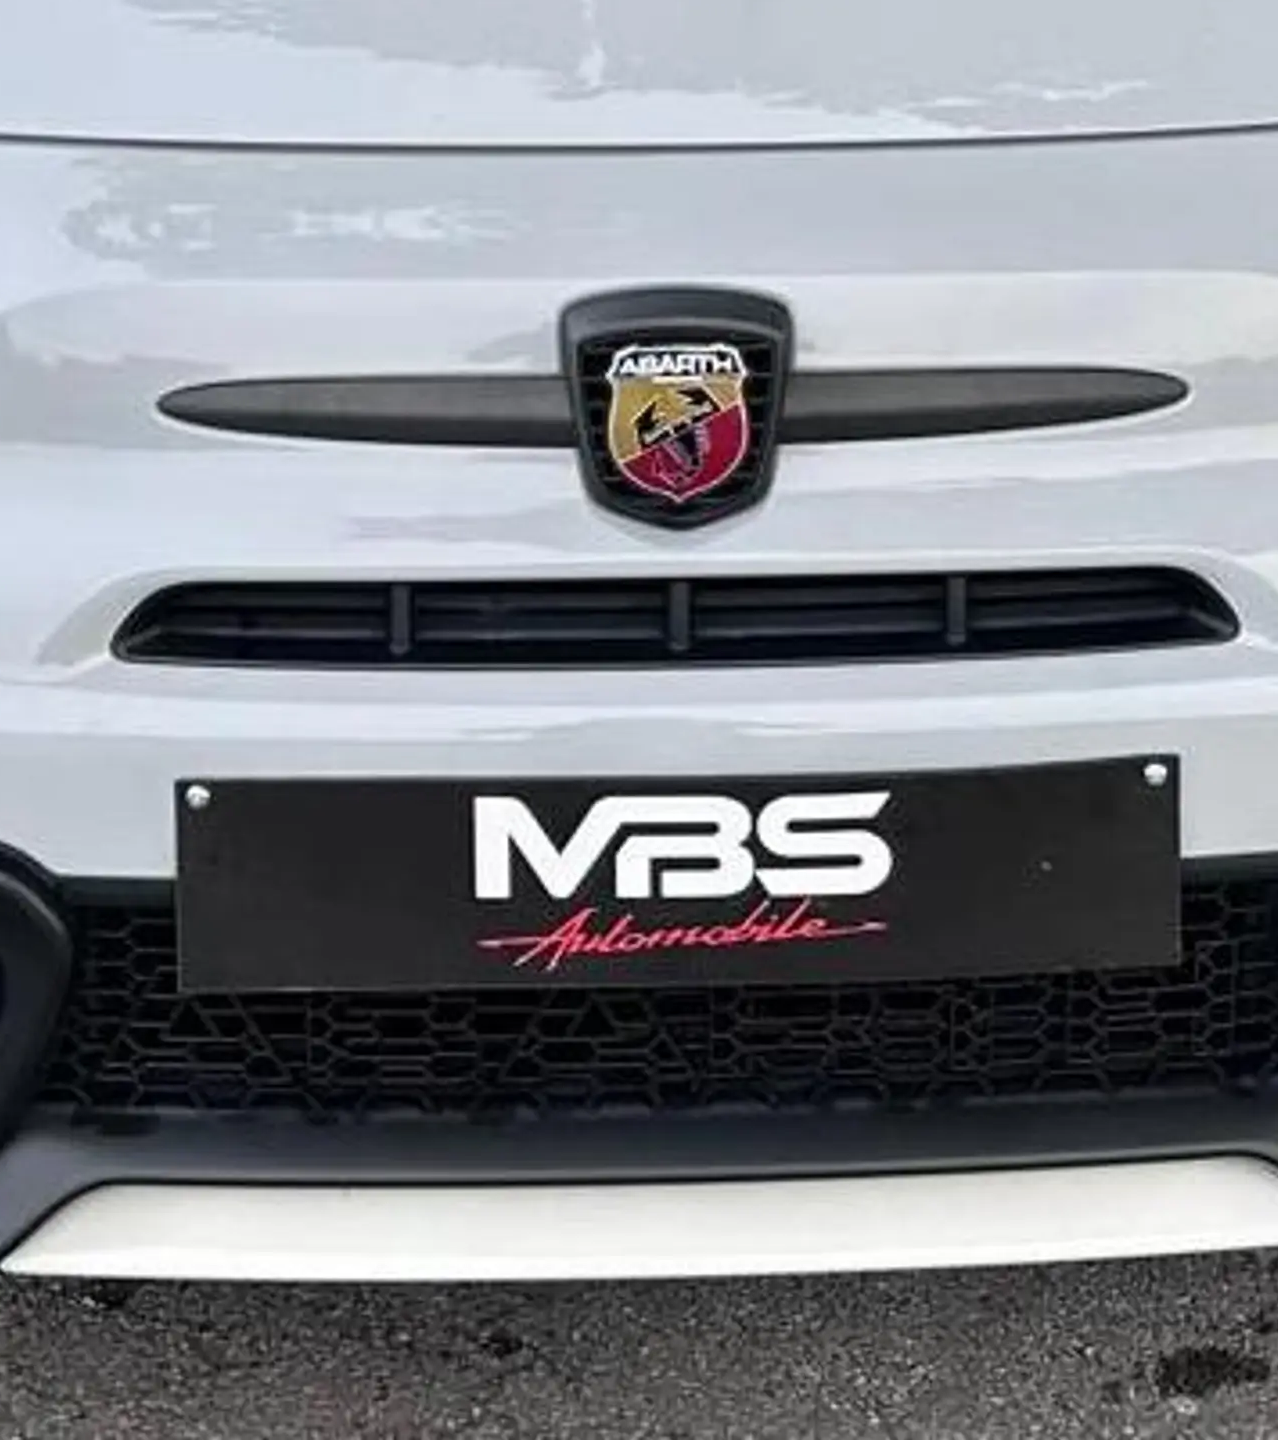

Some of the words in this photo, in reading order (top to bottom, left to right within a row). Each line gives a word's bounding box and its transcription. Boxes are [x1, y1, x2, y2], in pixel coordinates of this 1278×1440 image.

[620, 354, 733, 375] ABARTH
[473, 791, 893, 899] MBS
[477, 897, 887, 971] Automobile
